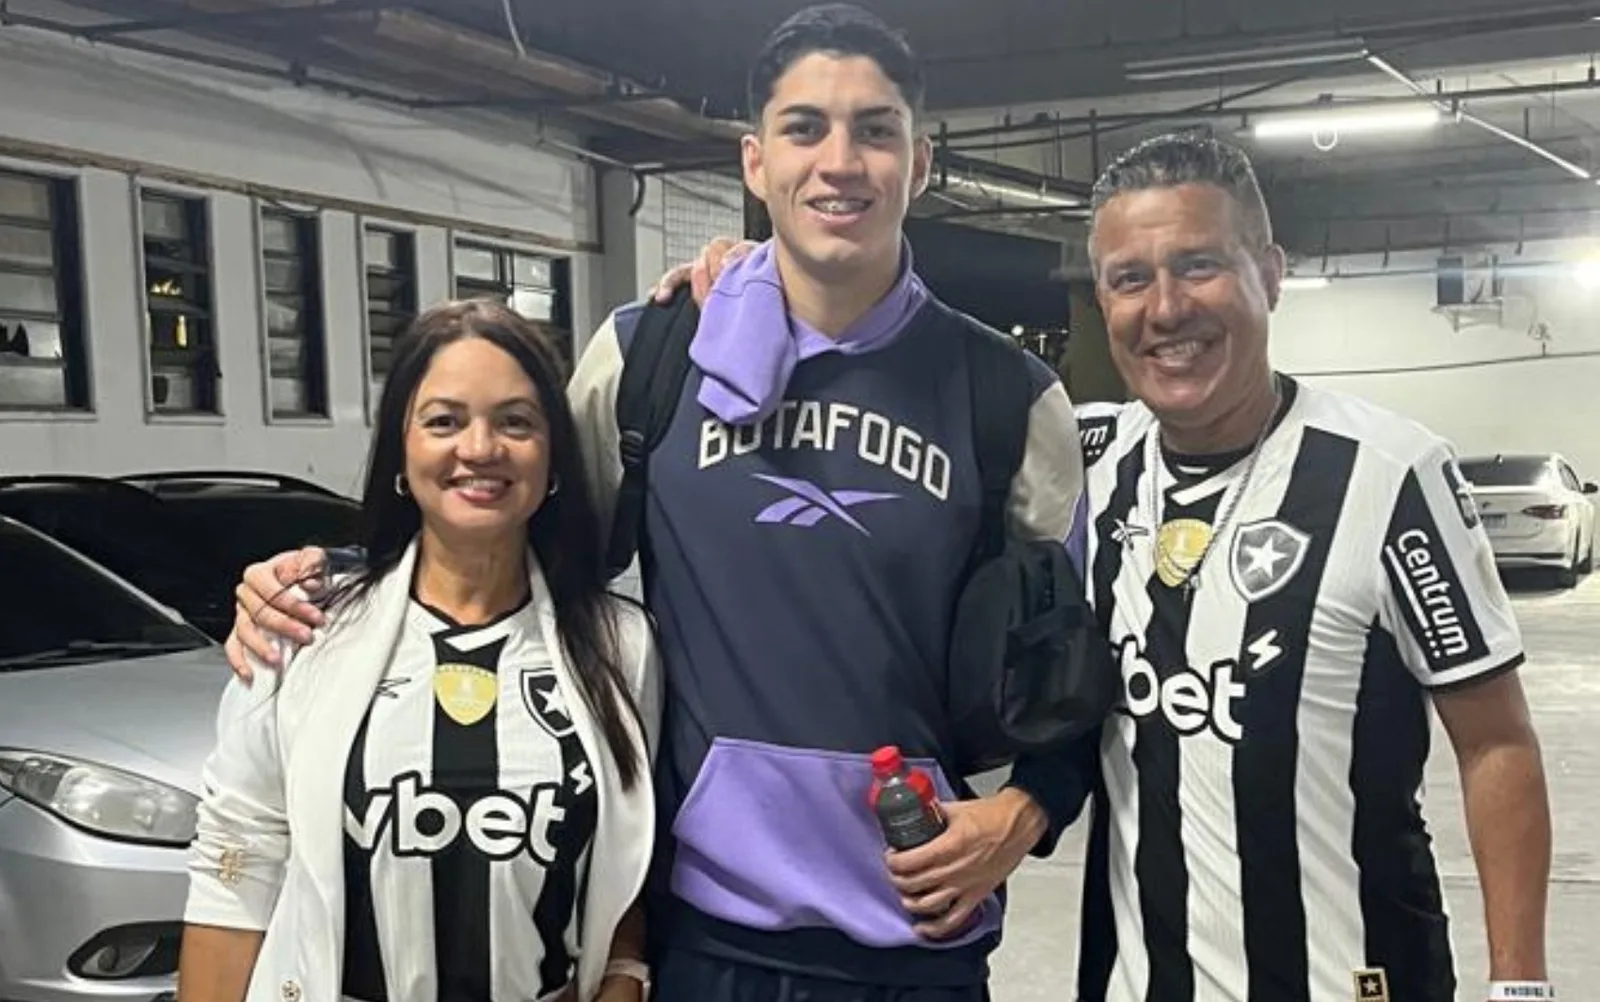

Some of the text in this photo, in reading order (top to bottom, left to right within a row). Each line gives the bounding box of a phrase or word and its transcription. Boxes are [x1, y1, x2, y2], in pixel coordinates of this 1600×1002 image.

[697, 400, 951, 501] BOTAFOGO
[1397, 528, 1470, 656] Centrum
[1119, 638, 1246, 740] bet
[342, 774, 566, 863] vbet
